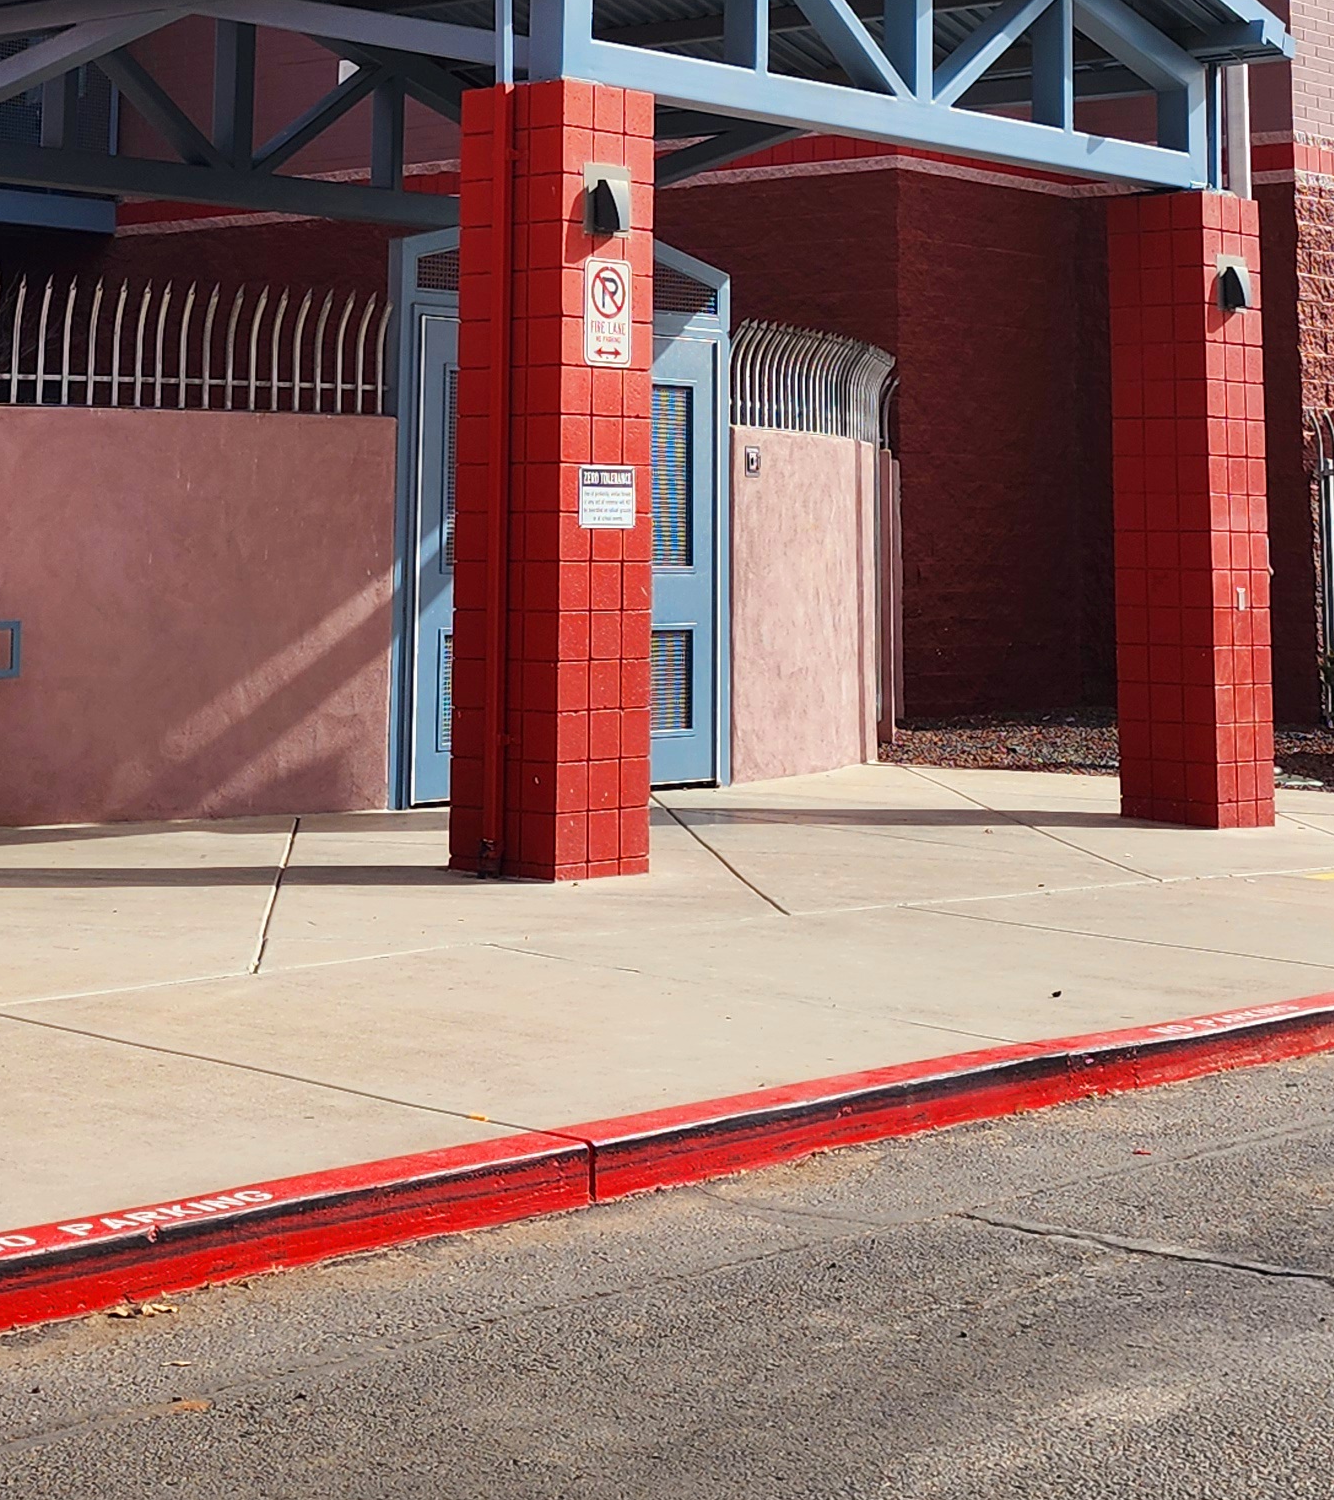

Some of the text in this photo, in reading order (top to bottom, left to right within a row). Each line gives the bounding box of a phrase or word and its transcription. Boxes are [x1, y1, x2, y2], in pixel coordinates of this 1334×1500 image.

[590, 320, 627, 336] FIRE LANE
[57, 1190, 274, 1236] PARKING
